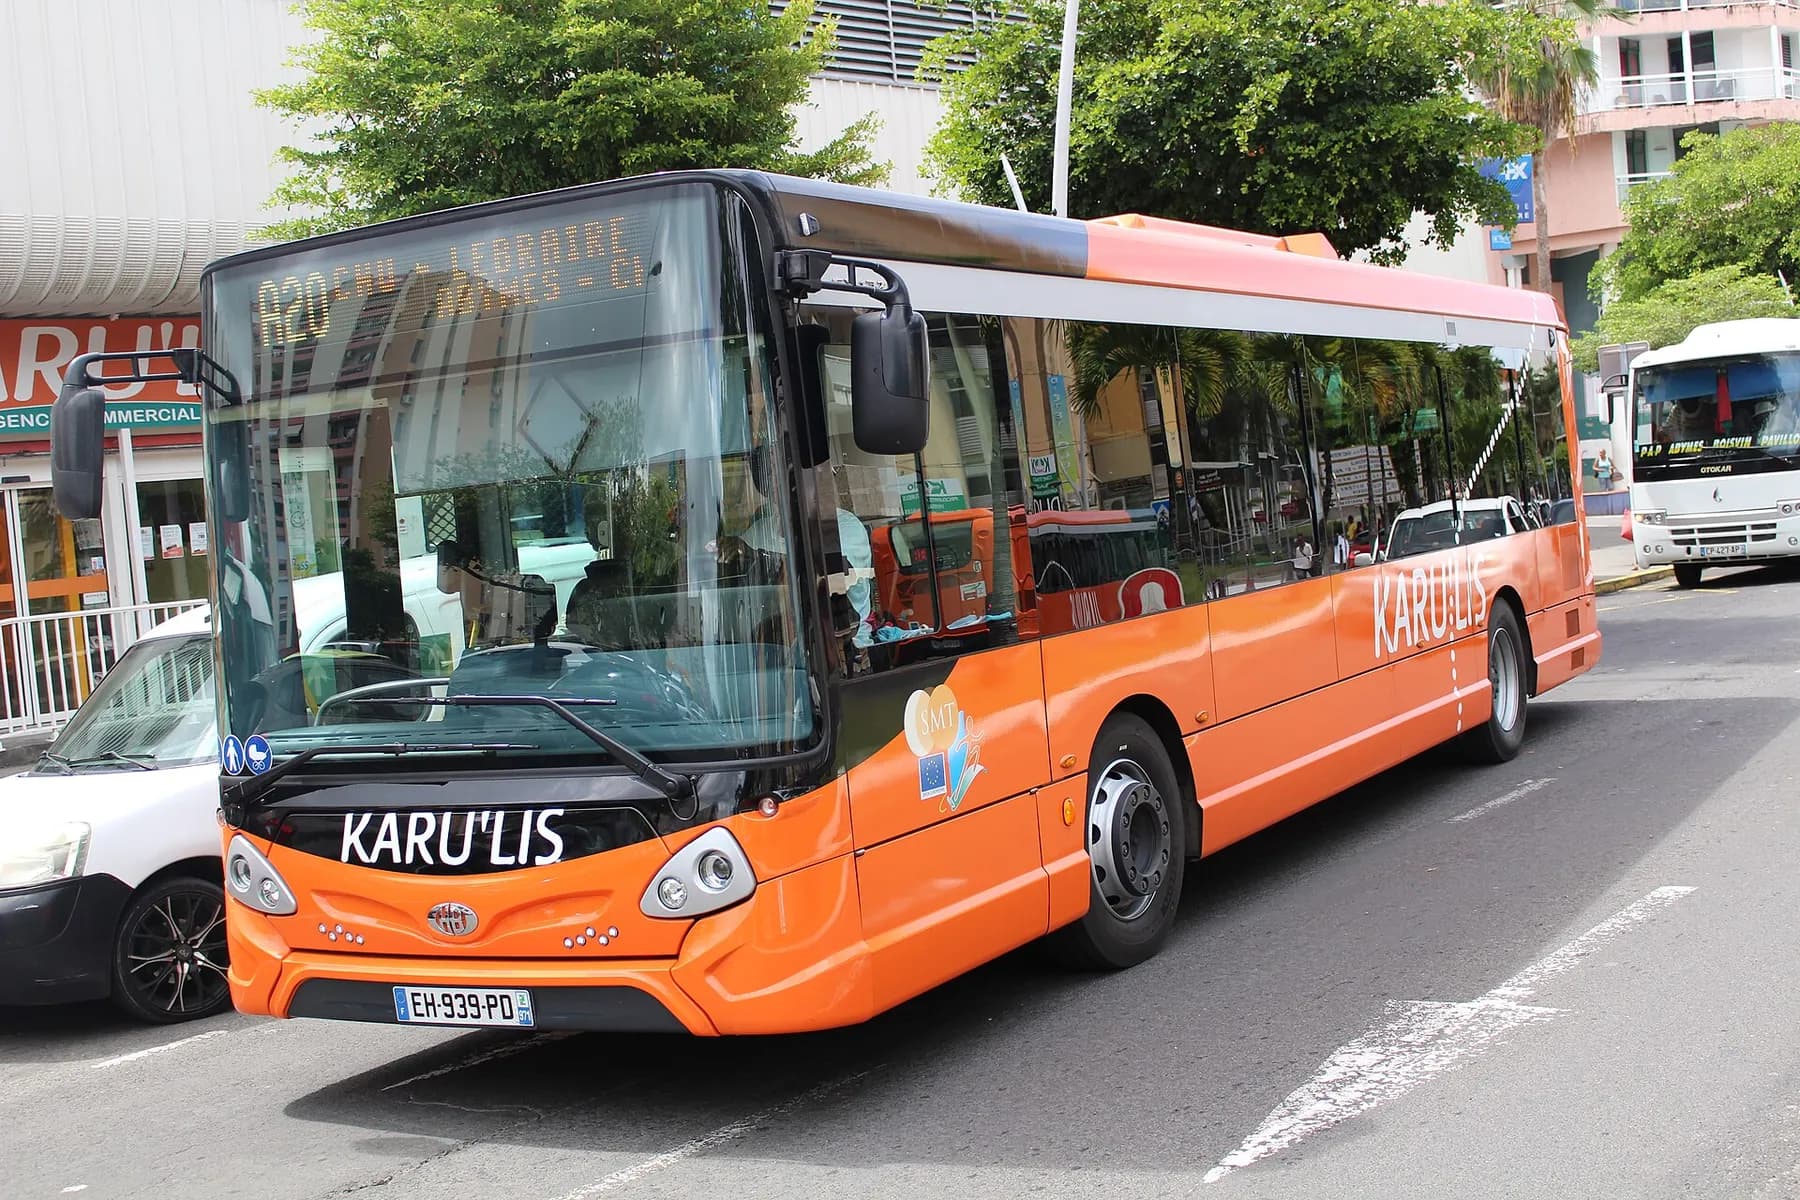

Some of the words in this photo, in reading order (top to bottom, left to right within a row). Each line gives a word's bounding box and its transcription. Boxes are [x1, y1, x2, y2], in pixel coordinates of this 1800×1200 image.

[258, 271, 331, 347] A20
[333, 257, 395, 301] CHU
[451, 215, 628, 281] LEBRAIRE
[436, 269, 561, 320] ABYMES
[1668, 439, 1704, 455] ABYMES
[1700, 464, 1732, 474] OTOKAR
[1374, 553, 1487, 659] KARU'LIS
[920, 702, 955, 736] SMT
[340, 809, 565, 866] KARU'LIS
[411, 991, 514, 1020] EH-939-PD
